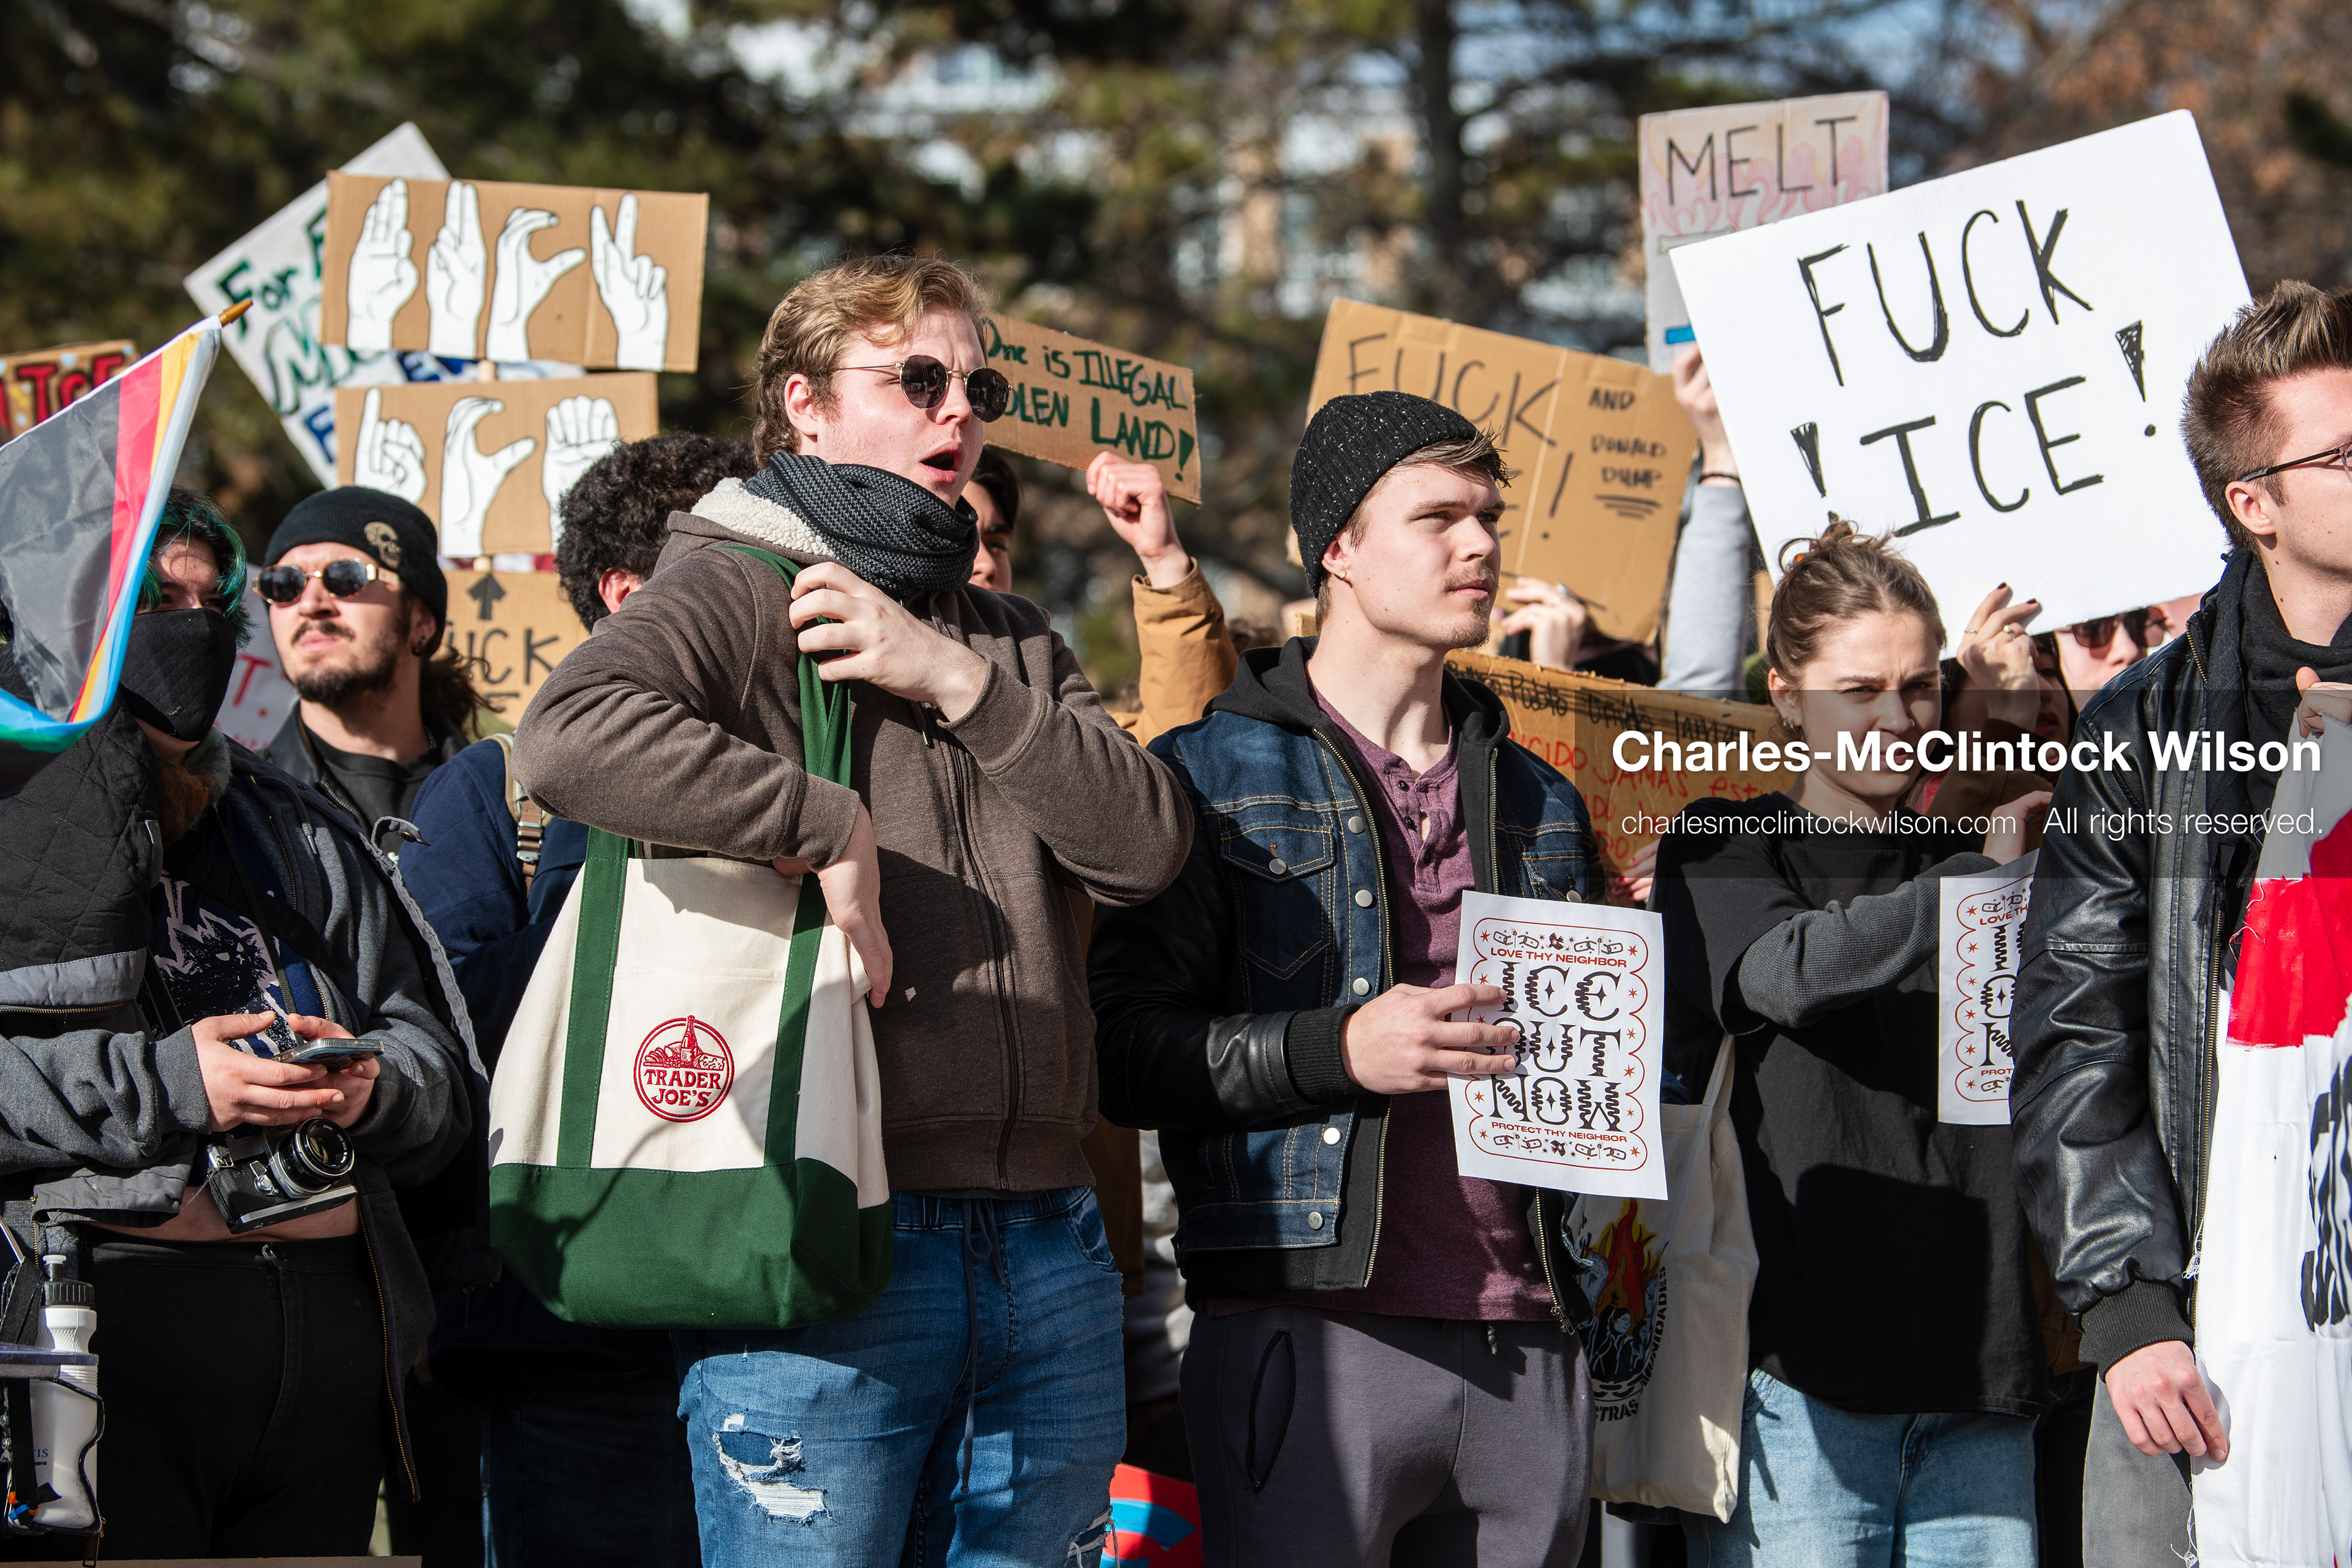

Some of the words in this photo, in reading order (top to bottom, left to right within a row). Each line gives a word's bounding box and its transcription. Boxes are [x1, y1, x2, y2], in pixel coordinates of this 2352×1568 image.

[1667, 115, 1858, 205] MELT
[1798, 200, 2093, 386] FUCK
[1042, 345, 1070, 379] is
[1073, 350, 1188, 410] ILLEGAL
[1346, 332, 1561, 447] FUCK
[1588, 386, 1636, 411] AND
[1091, 396, 1194, 482] LAND!
[1860, 375, 2103, 538] ICE
[446, 620, 559, 685] UCK
[1980, 910, 2013, 925] LOVE
[1491, 947, 1523, 959] LOVE
[1526, 951, 1553, 962] THY
[1556, 953, 1627, 968] NEIGHBOR
[1497, 960, 1622, 1021] ICE
[644, 1069, 722, 1090] TRADER
[650, 1088, 712, 1107] JOE'S
[1489, 1074, 1626, 1133] NOW
[1491, 1121, 1542, 1134] PROTECT
[1544, 1128, 1566, 1137] THY
[1568, 1131, 1627, 1142] NEIGHBOR
[34, 1448, 48, 1458] IS
